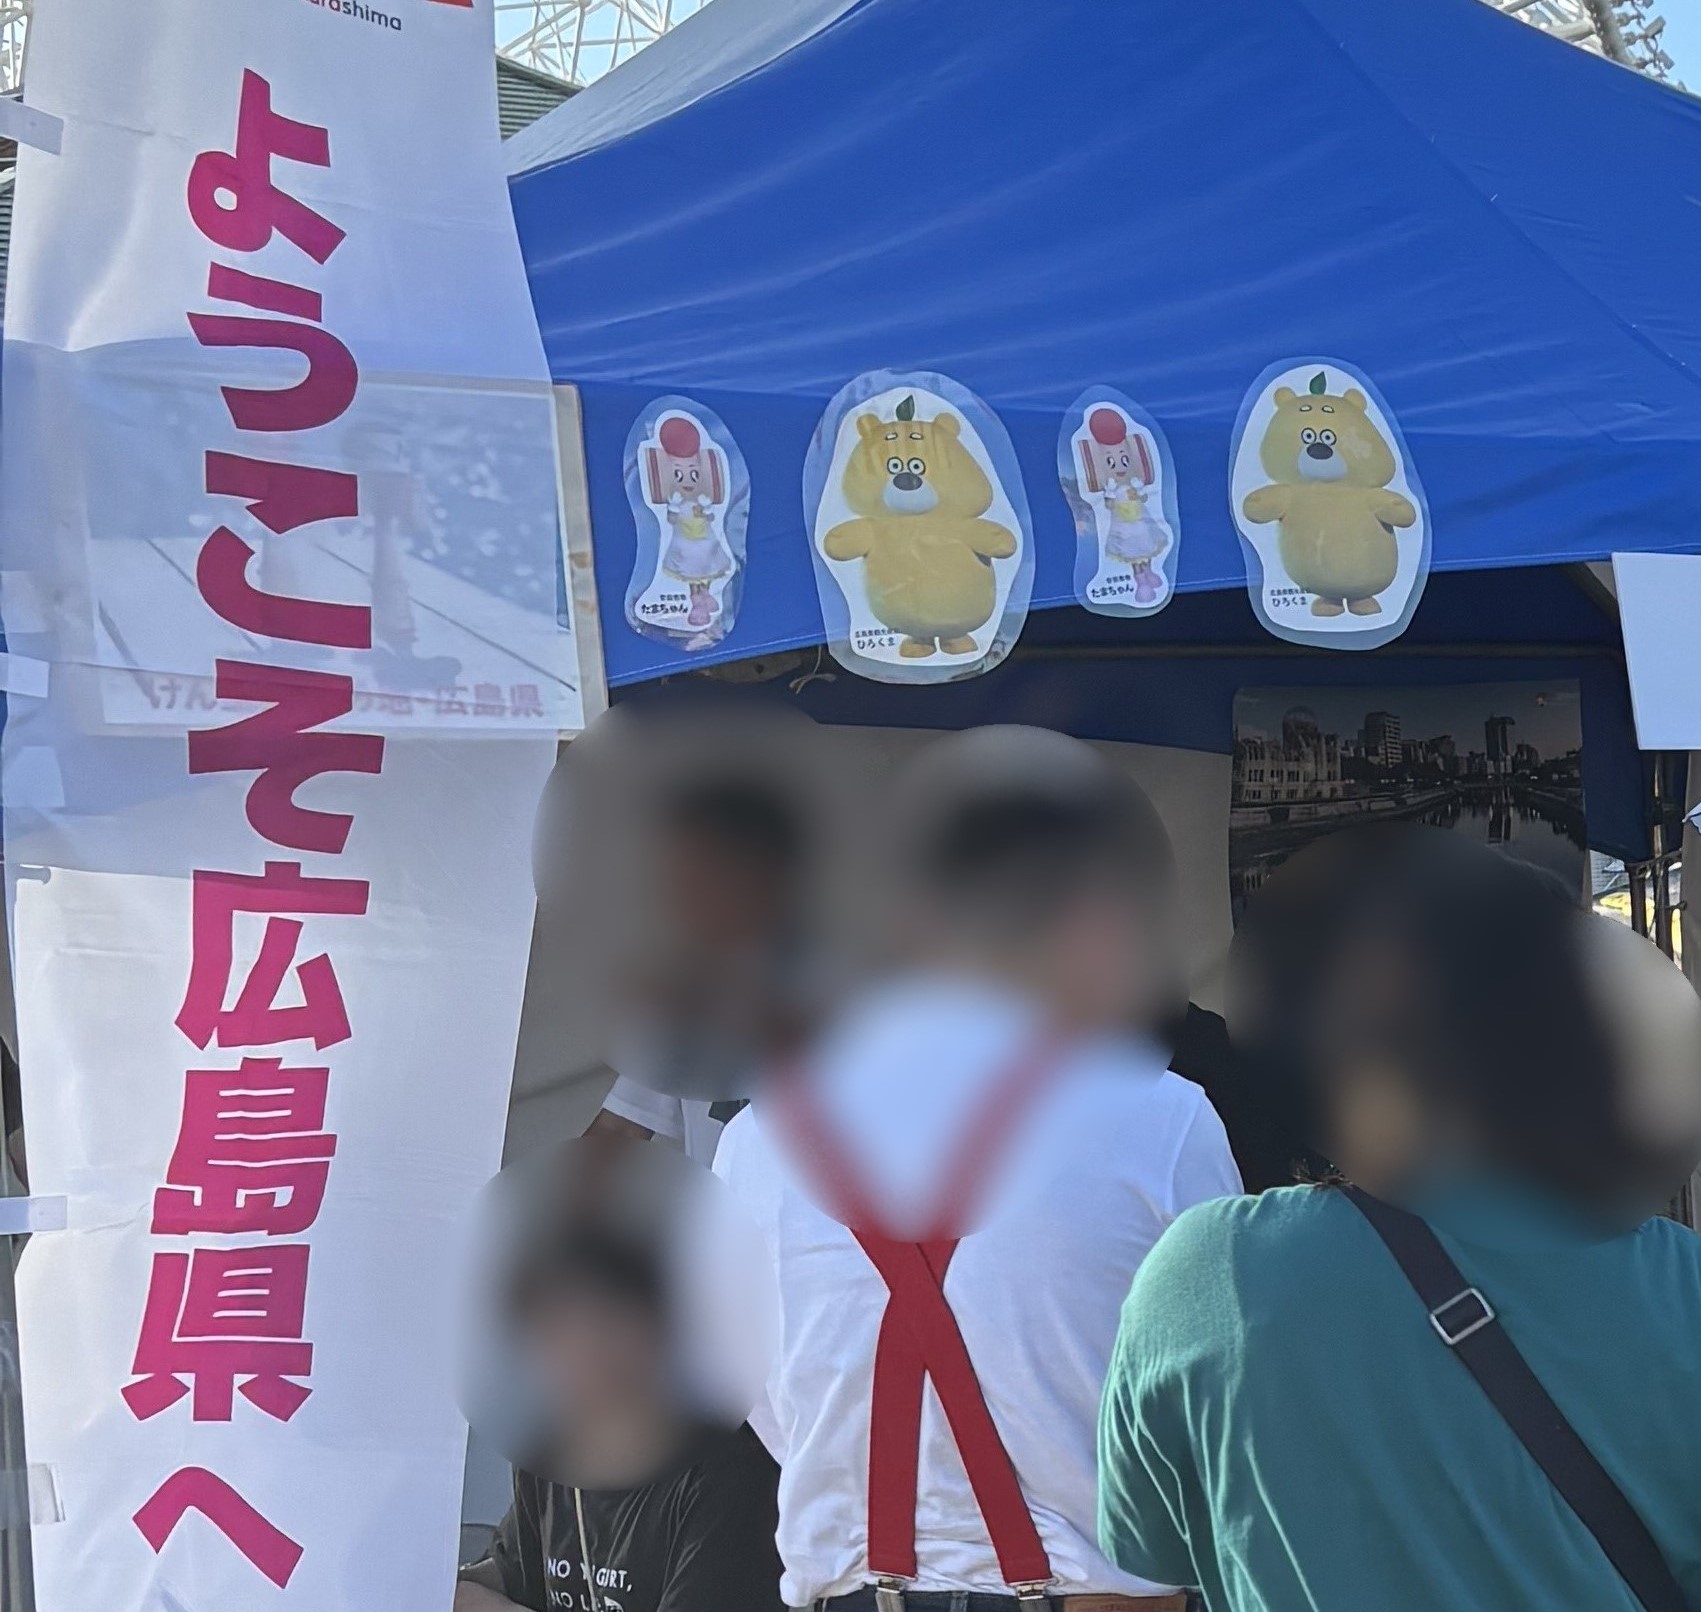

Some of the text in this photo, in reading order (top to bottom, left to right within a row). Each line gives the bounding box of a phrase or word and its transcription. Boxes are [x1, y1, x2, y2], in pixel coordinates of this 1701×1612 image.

[120, 67, 386, 1589] ようこそ広島県へ
[548, 1558, 571, 1578] NO
[550, 1588, 574, 1608] NO
